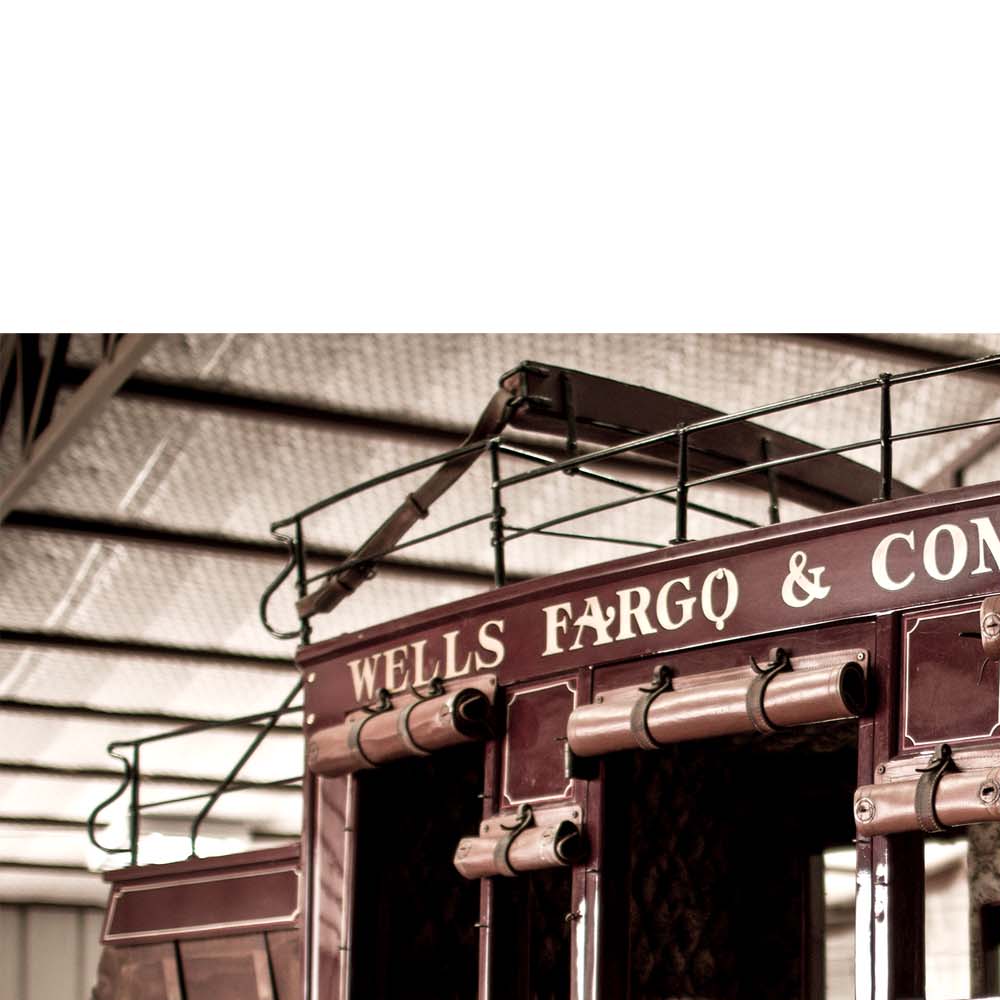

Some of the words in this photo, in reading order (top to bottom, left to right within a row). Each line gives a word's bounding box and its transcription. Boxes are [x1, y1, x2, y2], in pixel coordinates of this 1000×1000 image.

[348, 619, 506, 702] WELLS
[542, 567, 740, 657] FARGO
[781, 550, 832, 608] &
